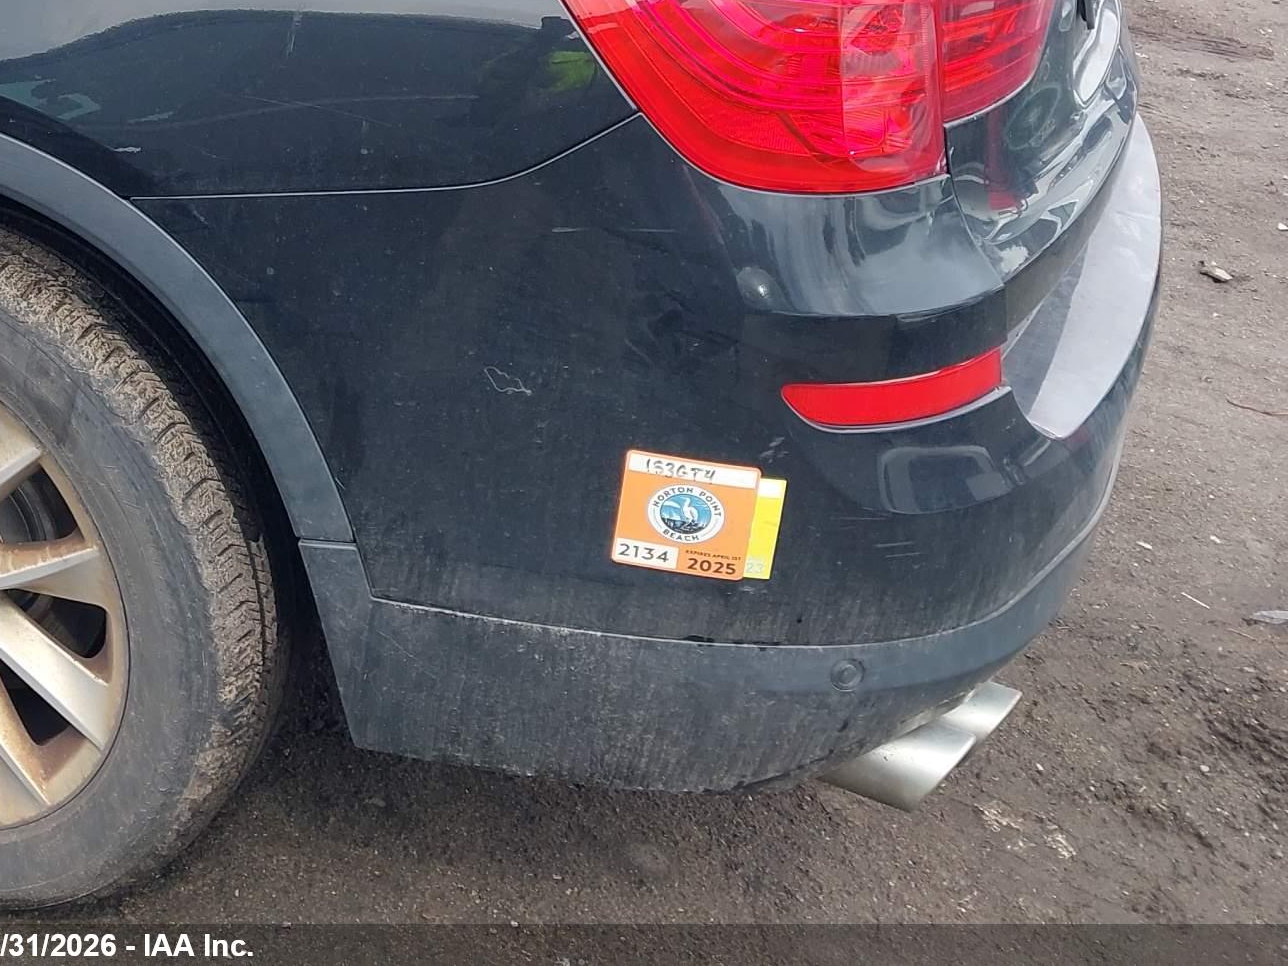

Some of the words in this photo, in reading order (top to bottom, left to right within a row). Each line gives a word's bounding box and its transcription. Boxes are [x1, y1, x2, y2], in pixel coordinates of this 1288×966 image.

[698, 490, 722, 518] POINT
[662, 528, 700, 542] BEACH
[618, 542, 669, 563] 2134
[687, 557, 737, 575] 2025
